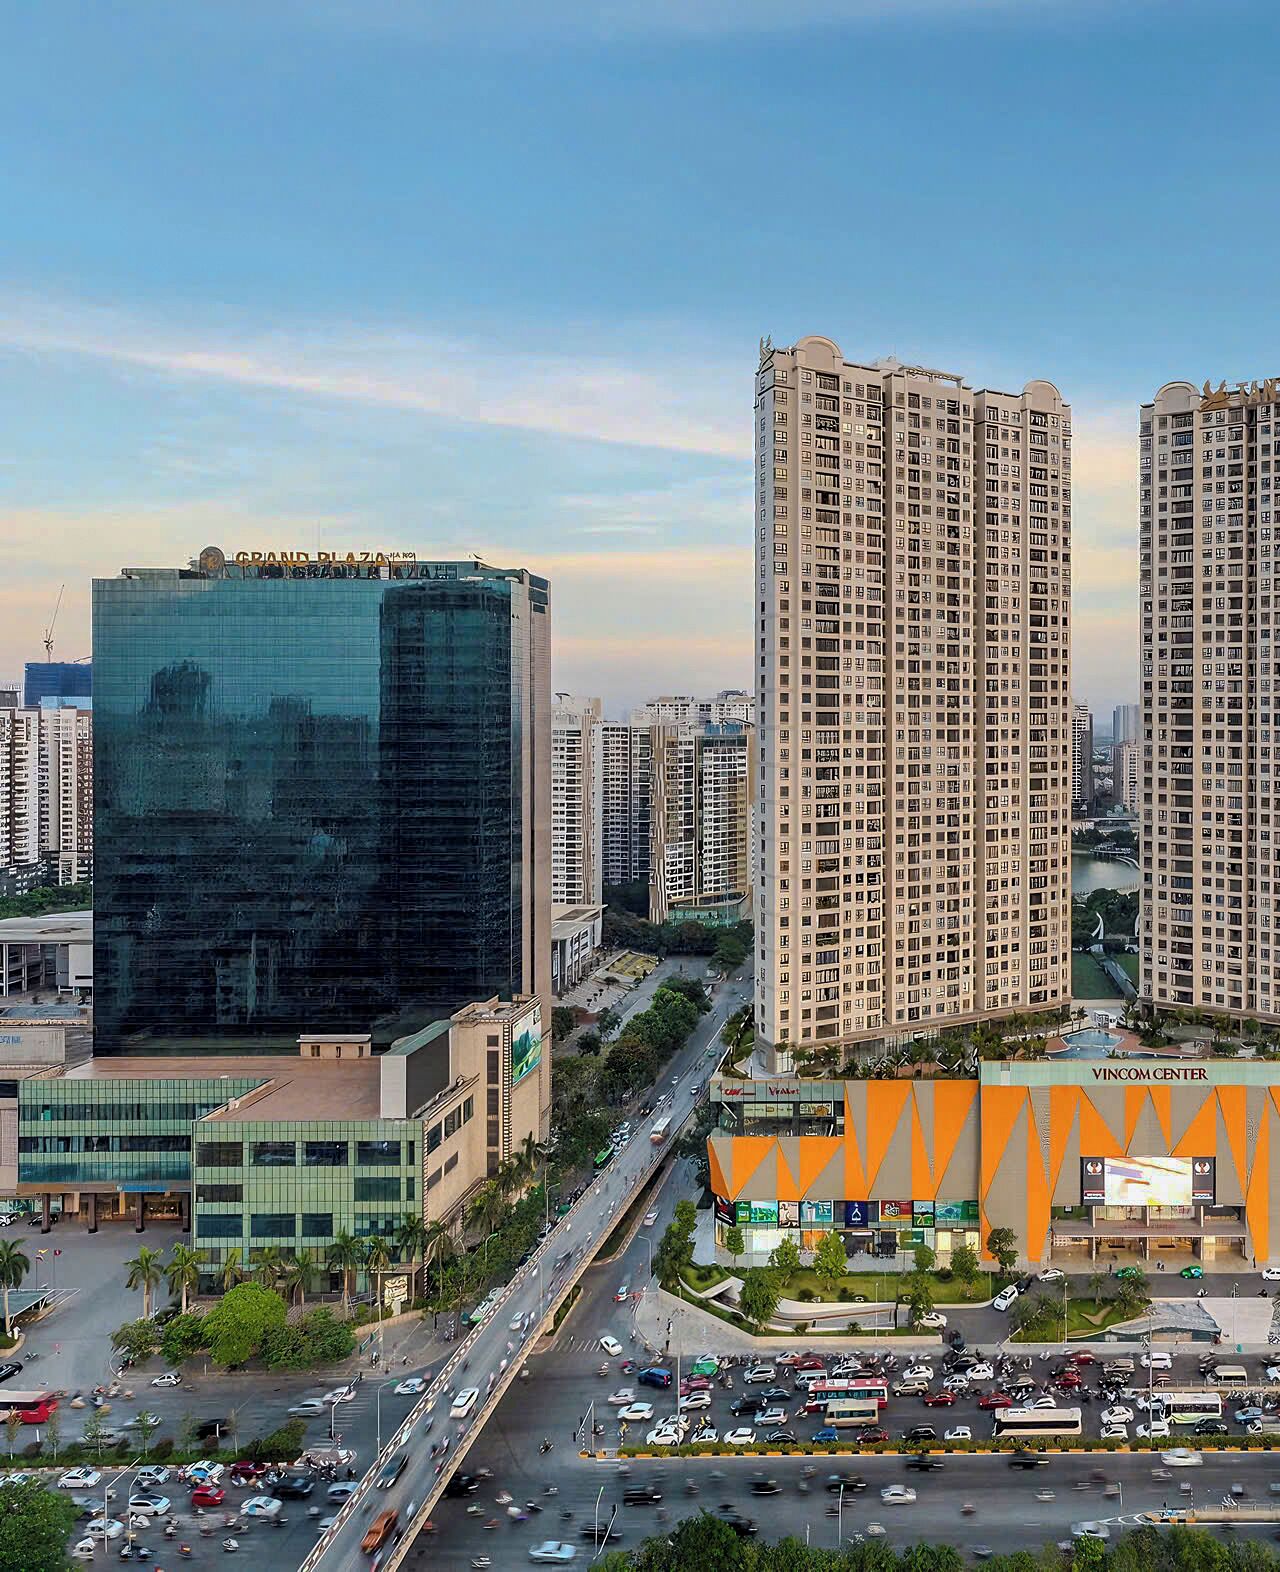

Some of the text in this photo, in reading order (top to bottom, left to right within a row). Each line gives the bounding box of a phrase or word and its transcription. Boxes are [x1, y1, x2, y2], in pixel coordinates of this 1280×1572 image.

[235, 551, 309, 567] GRAND
[317, 551, 387, 567] PLAZA
[1092, 1068, 1209, 1081] VINCOM CENTER
